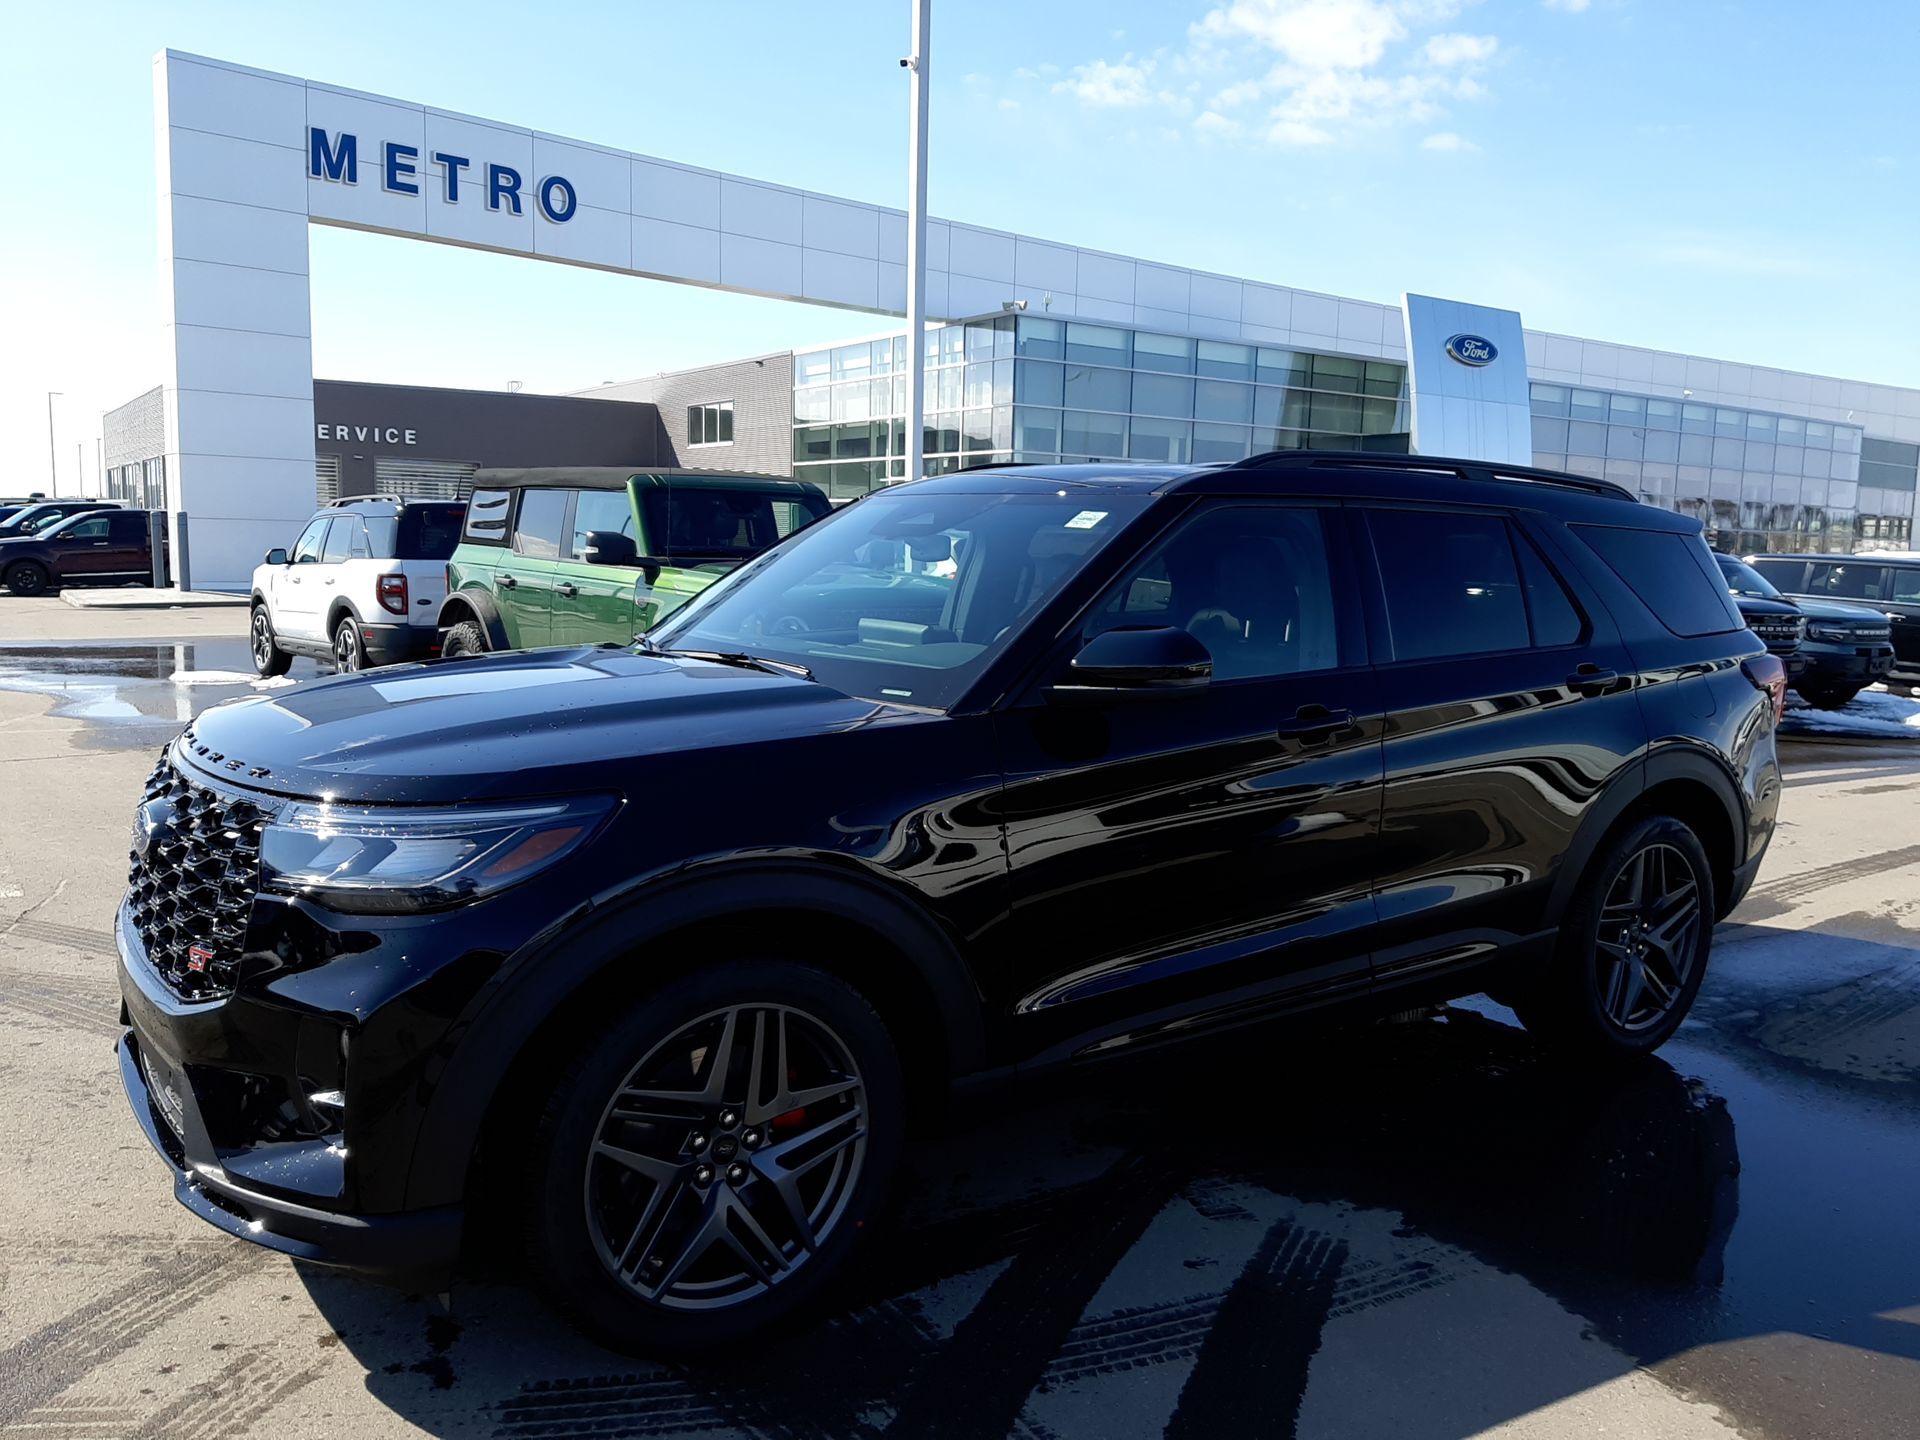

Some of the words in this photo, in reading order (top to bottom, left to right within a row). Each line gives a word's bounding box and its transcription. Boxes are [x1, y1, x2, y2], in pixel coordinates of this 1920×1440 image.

[310, 126, 577, 223] METRO
[1462, 339, 1489, 359] Ford
[317, 424, 417, 445] ERVICE
[188, 946, 213, 972] ST
